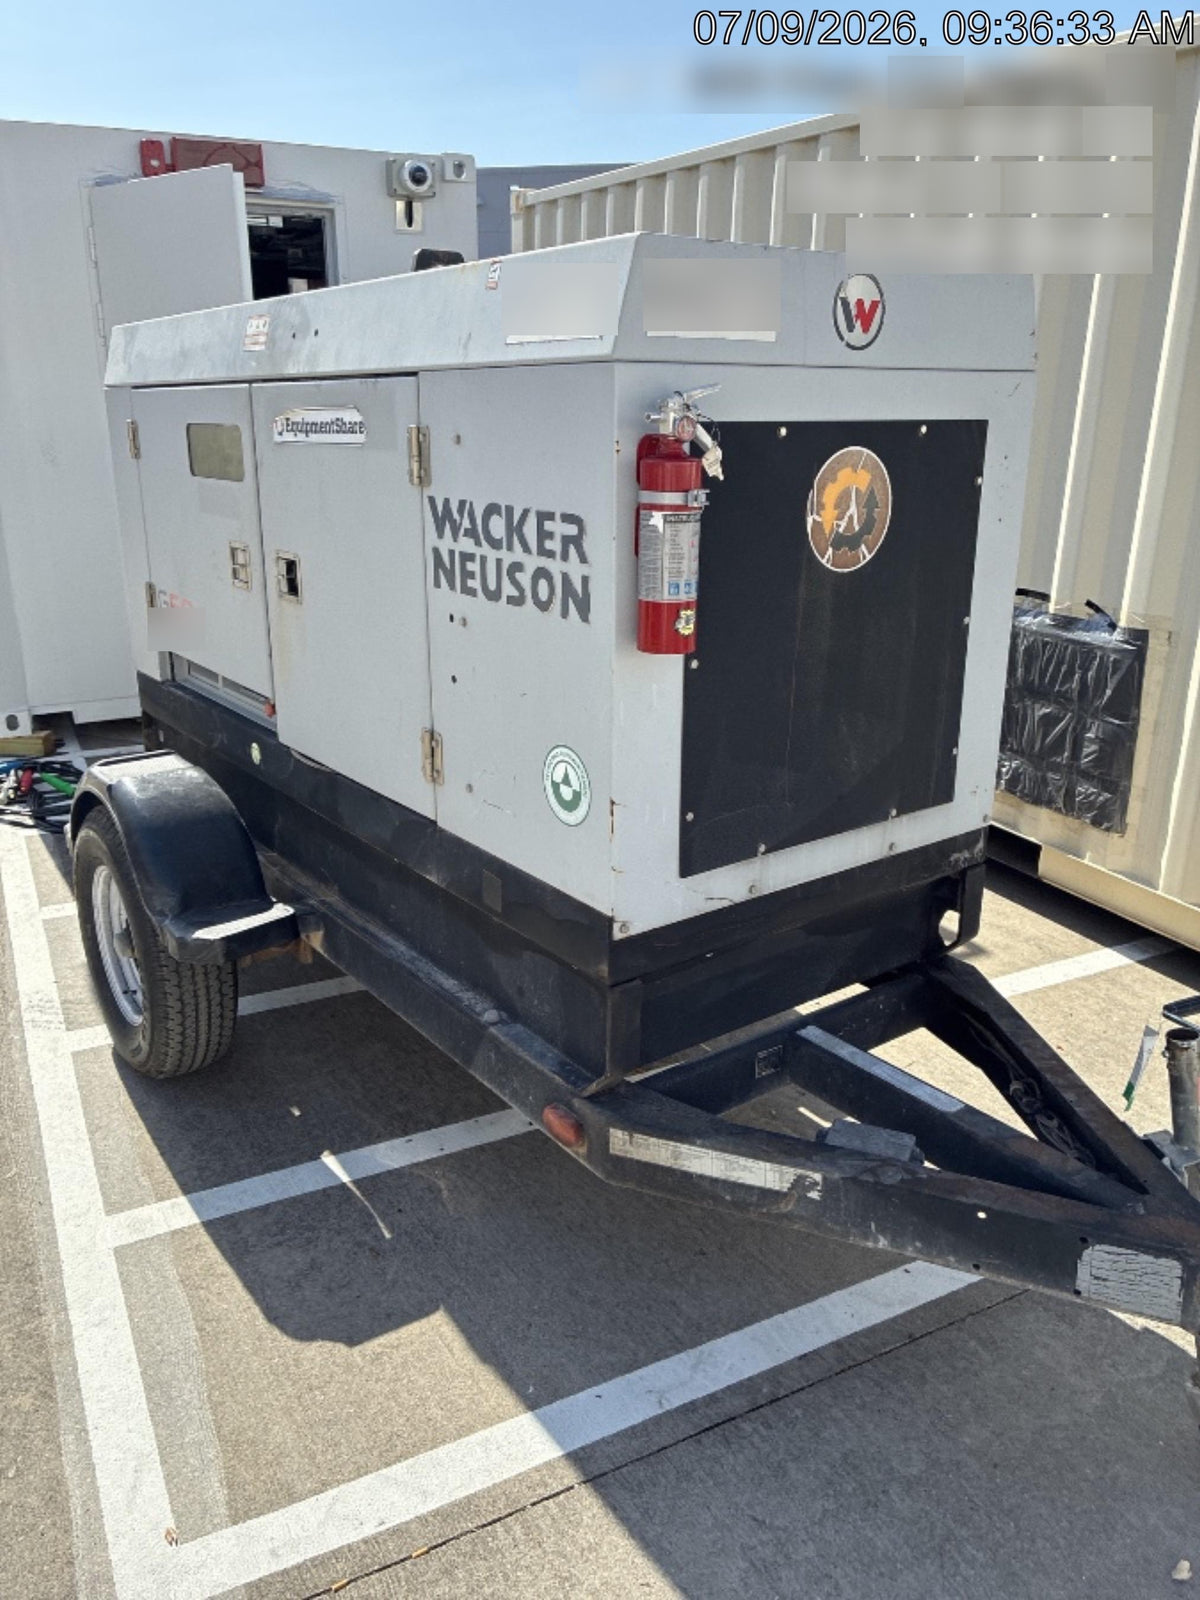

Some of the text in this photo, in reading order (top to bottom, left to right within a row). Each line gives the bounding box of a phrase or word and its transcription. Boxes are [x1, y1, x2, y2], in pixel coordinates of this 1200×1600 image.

[285, 417, 366, 438] EquipmentShare
[427, 495, 590, 565] WACKER
[432, 546, 591, 624] NEUSON
